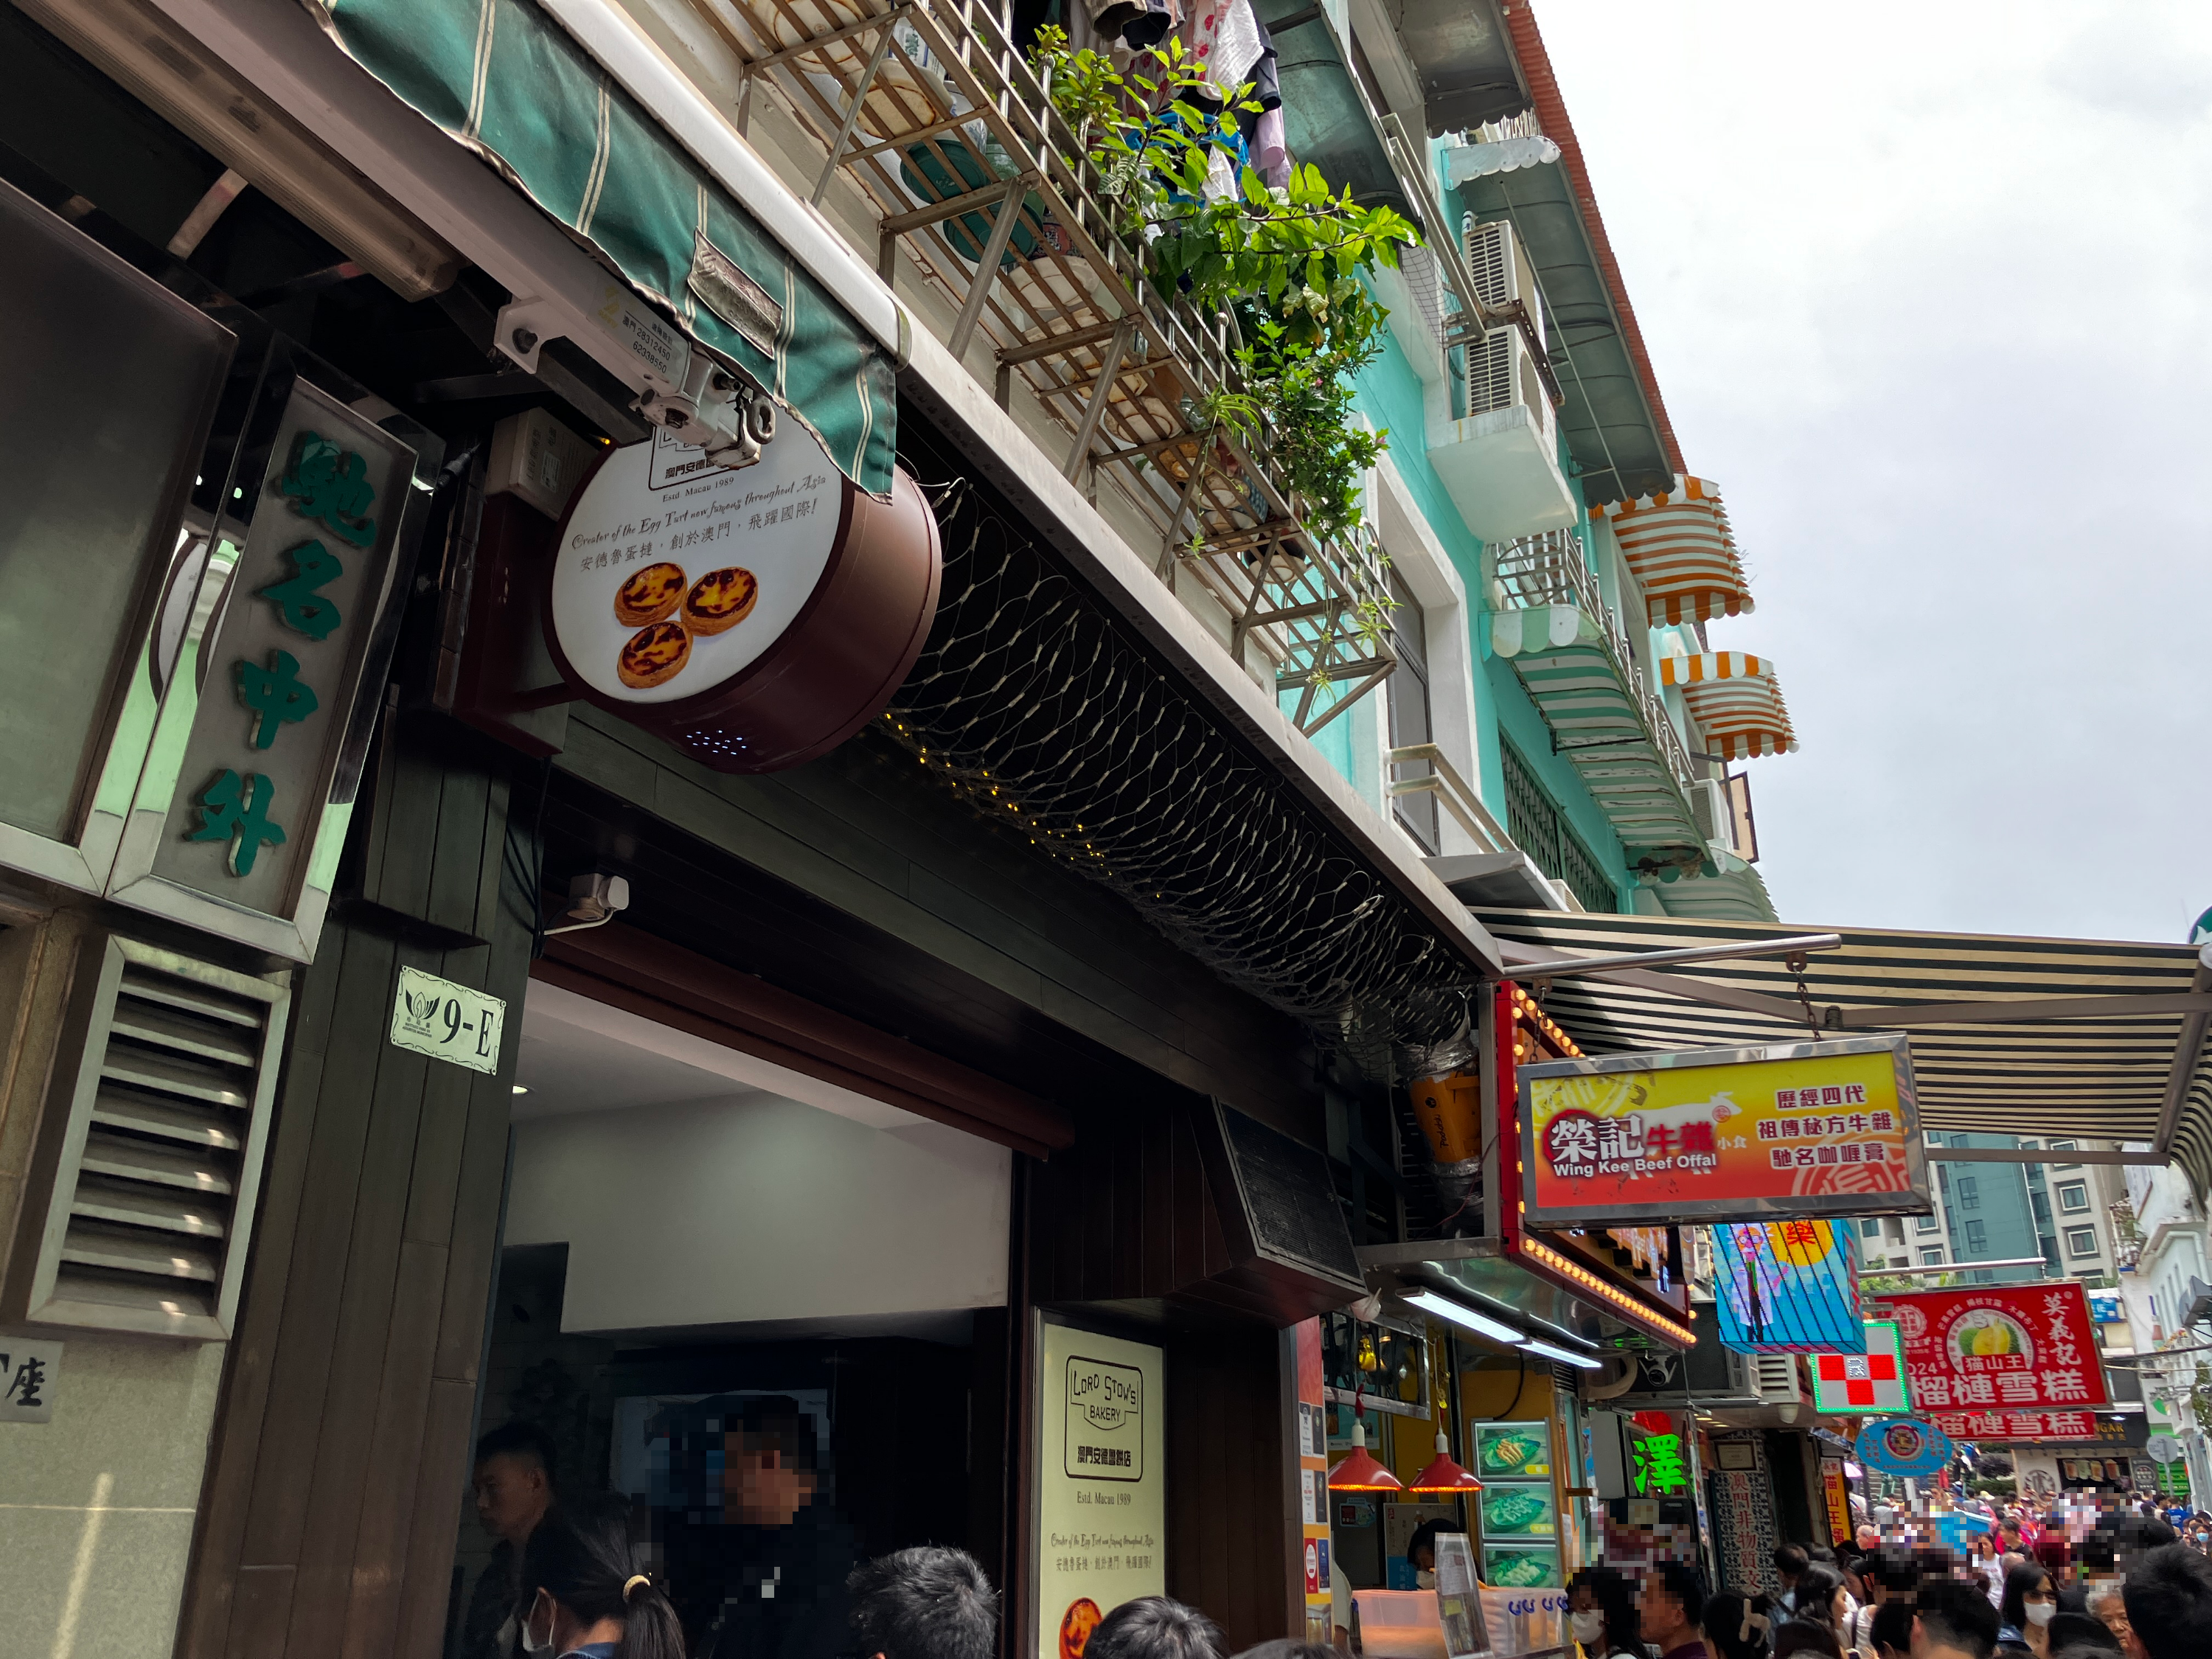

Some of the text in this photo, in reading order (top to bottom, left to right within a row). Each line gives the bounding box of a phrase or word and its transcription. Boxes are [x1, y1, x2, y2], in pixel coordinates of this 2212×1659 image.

[633, 341, 667, 374] 62338550
[636, 328, 670, 361] 28312450
[685, 484, 712, 497] Macau
[714, 476, 734, 489] 1989
[572, 474, 827, 550] Creator of the Egg Tart now famous throughout Asia
[184, 431, 378, 877] 馳名中外
[439, 998, 494, 1057] 9-E
[1551, 1114, 1747, 1163] 榮記 牛雜 小食
[1758, 1112, 1893, 1139] 祖傳秘方牛雜
[1554, 1153, 1717, 1178] Wing Kee Beef Offal
[1937, 1304, 1964, 1331] 芒果雪糕
[1966, 1297, 2003, 1308] 楊枝甘露
[2042, 1292, 2083, 1366] 莫義記
[1910, 1368, 2090, 1406] 榴槤雪糕
[1090, 1405, 1121, 1422] BAKERY
[1077, 1445, 1131, 1467] 澳門安德魯餅店
[1632, 1433, 1687, 1495] 澤
[1077, 1490, 1131, 1506] Estd. Macau 1989
[1051, 1532, 1068, 1547] Creator
[1080, 1534, 1091, 1550] Egg
[1091, 1534, 1102, 1547] Tart
[1730, 1472, 1761, 1595] 澳門非物質文
